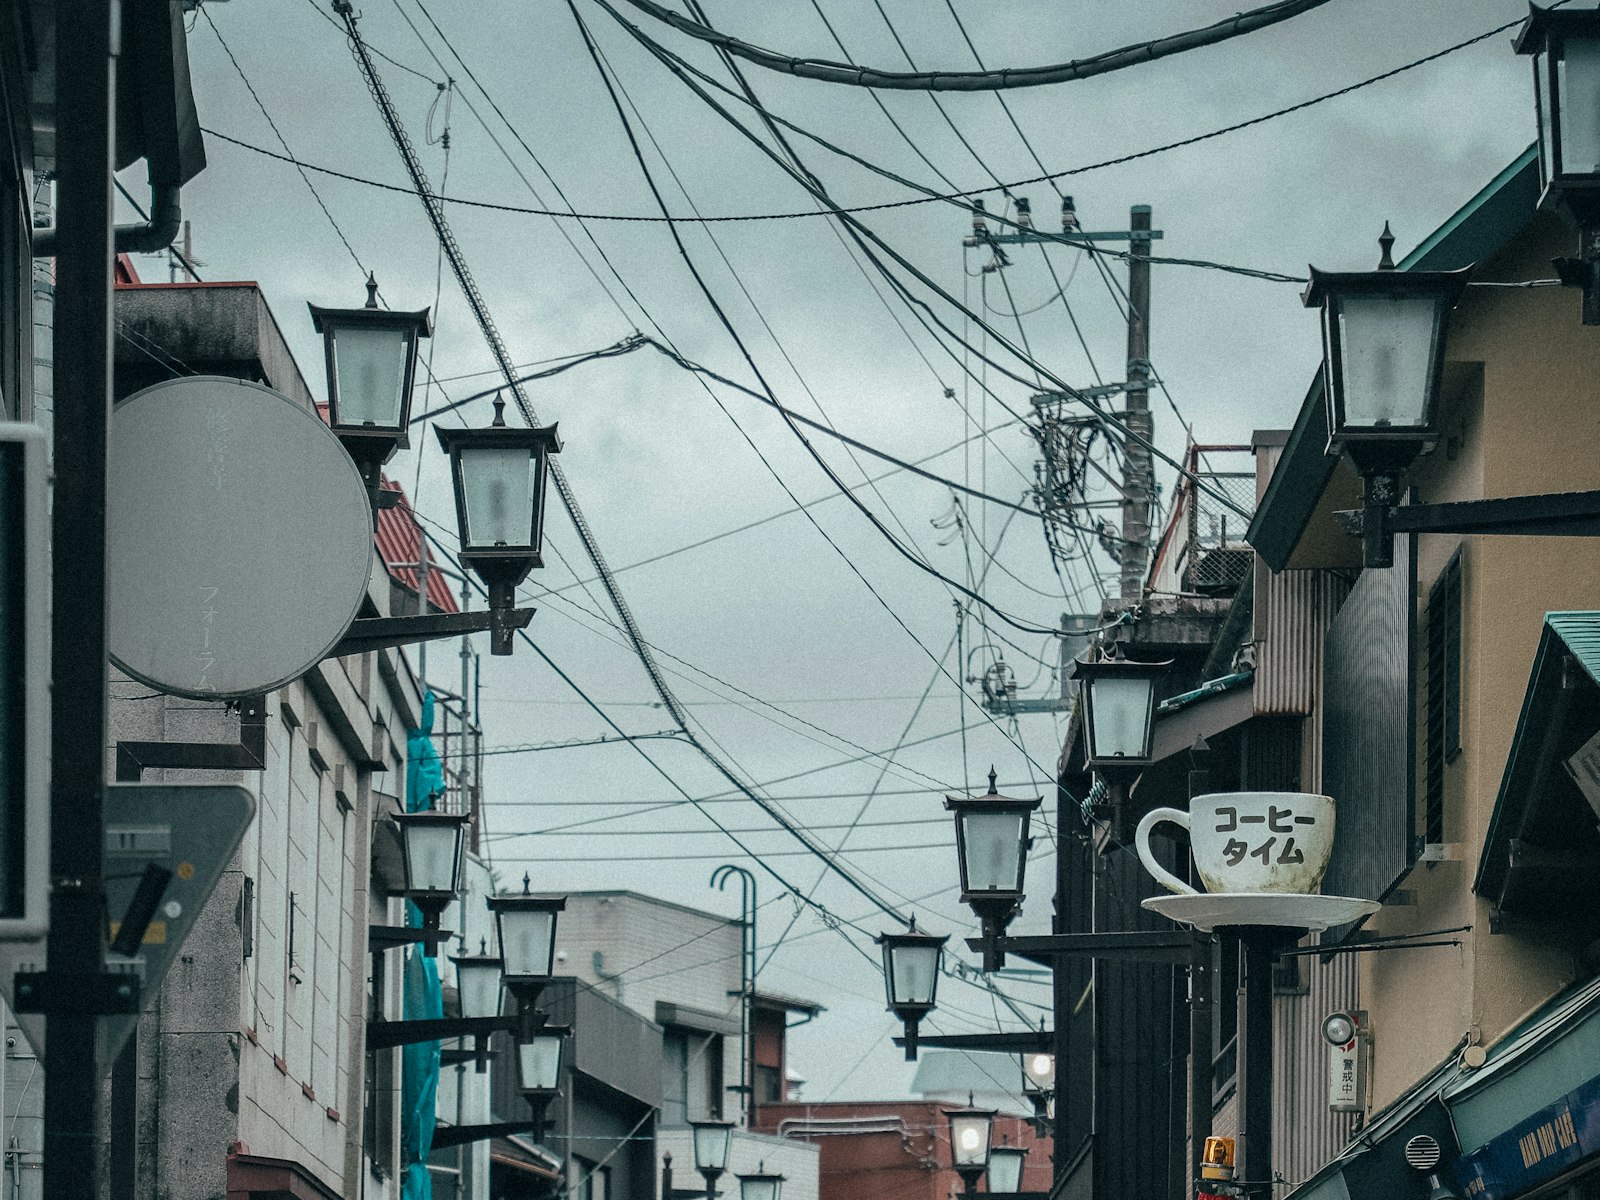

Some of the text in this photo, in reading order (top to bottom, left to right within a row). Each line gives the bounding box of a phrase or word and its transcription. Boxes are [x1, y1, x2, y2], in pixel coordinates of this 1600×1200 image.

[1215, 805, 1315, 833] コーヒー
[1222, 836, 1304, 866] タイム
[1342, 1058, 1354, 1094] 警戒中
